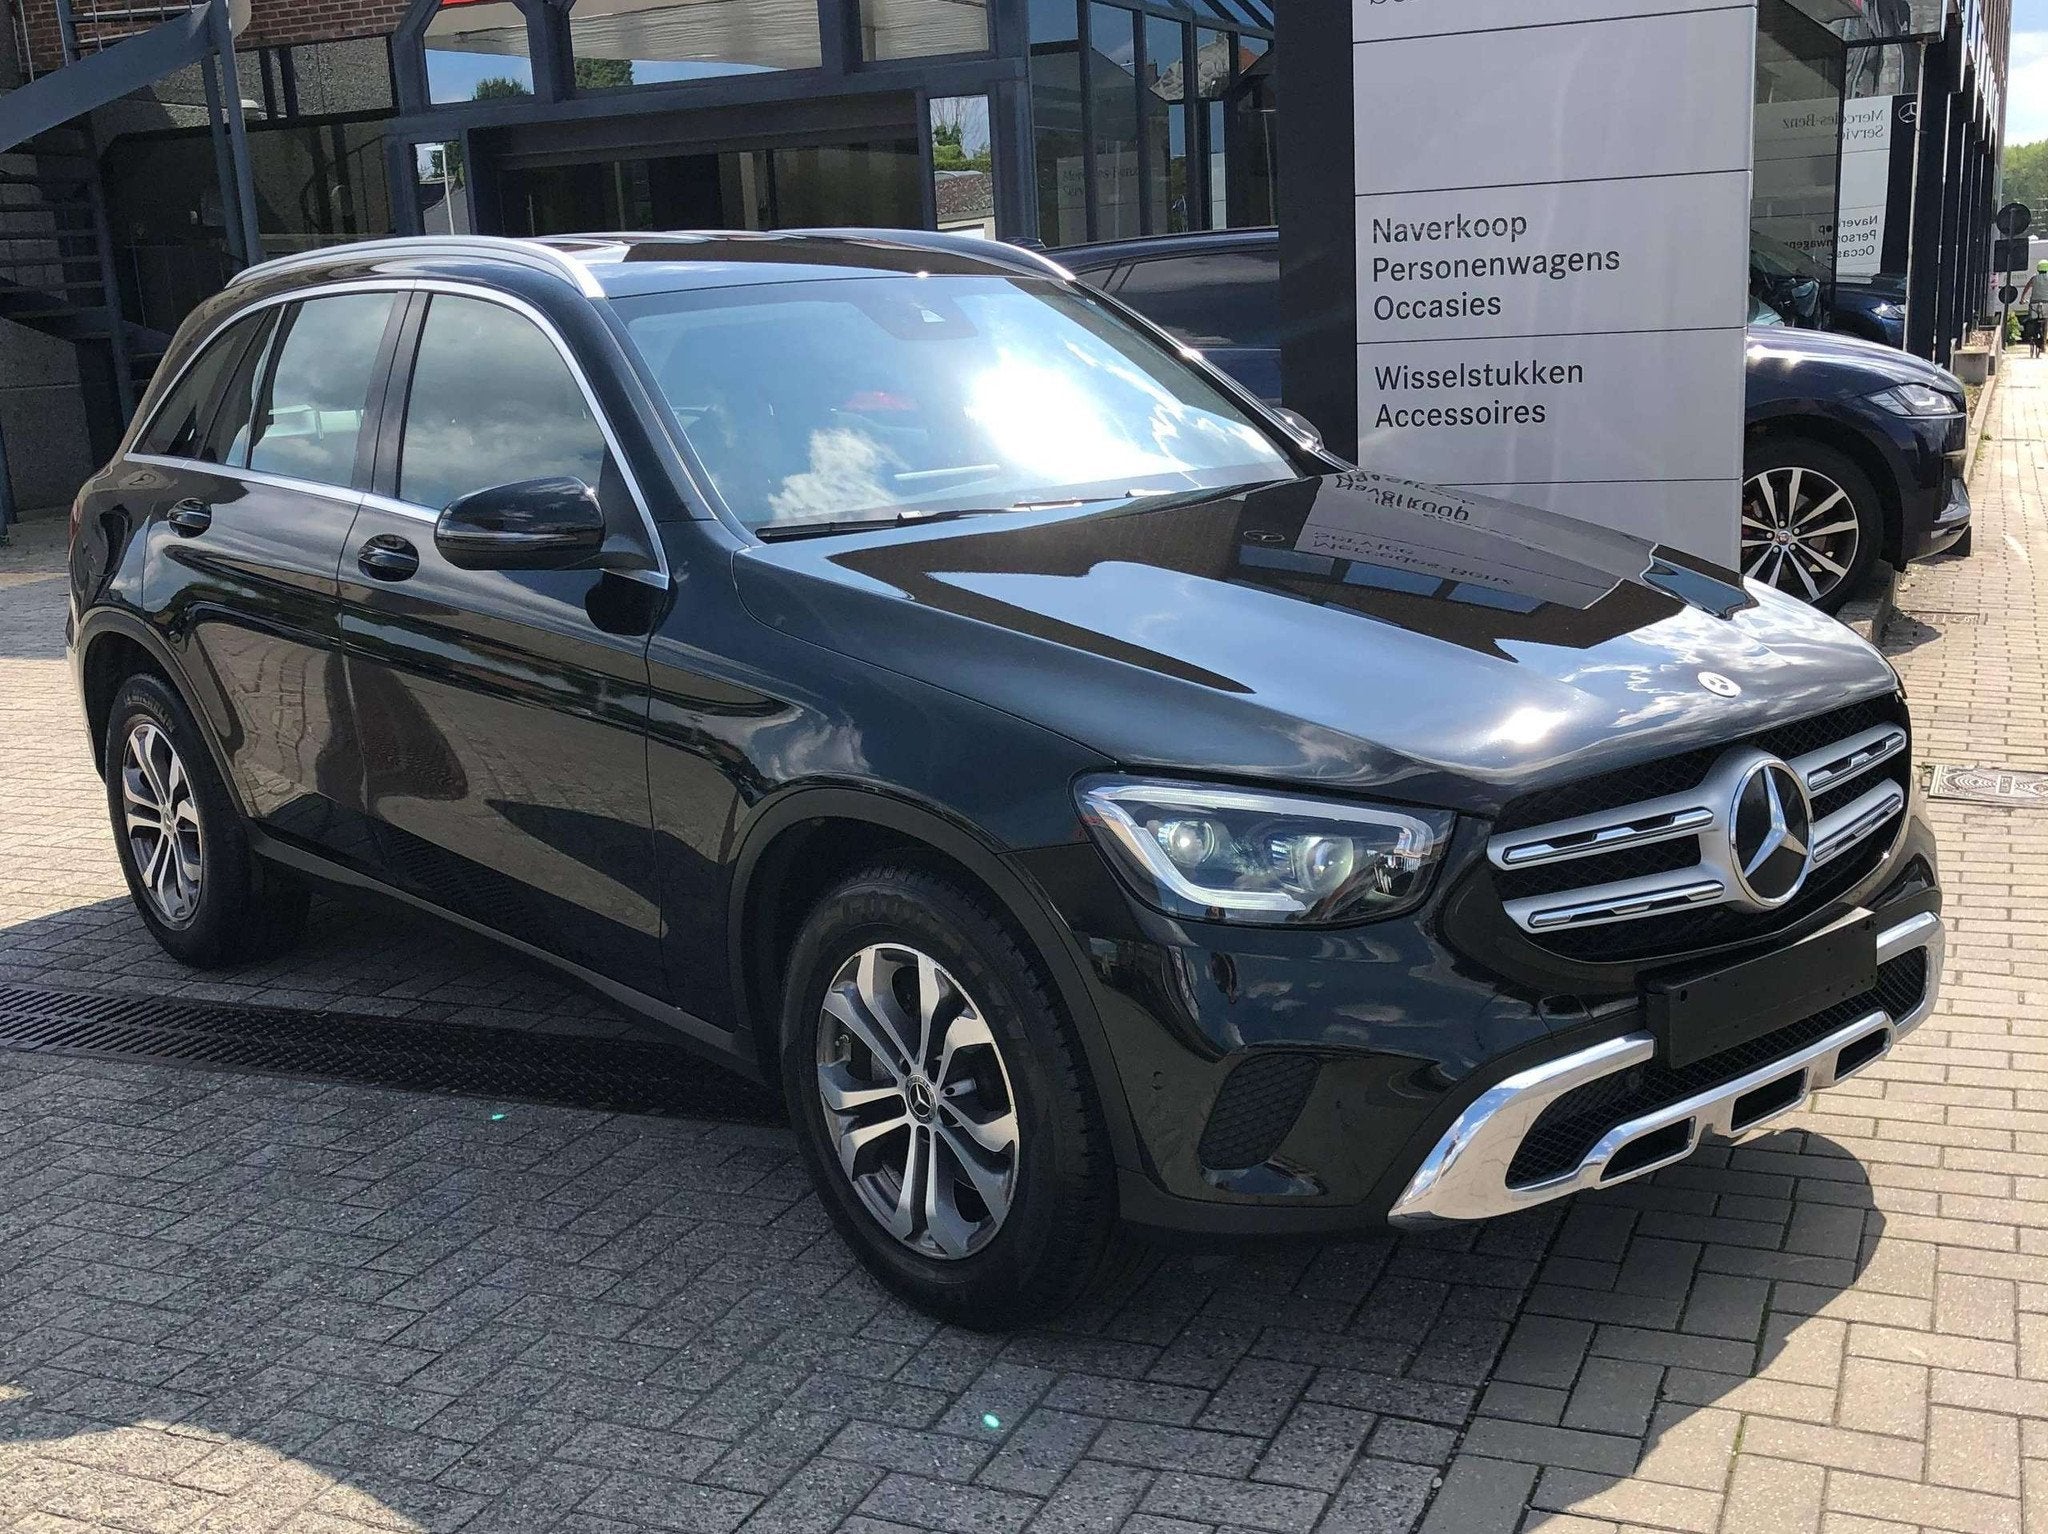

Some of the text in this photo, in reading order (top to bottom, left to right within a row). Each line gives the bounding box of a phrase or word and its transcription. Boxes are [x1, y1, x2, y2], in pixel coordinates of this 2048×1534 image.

[1373, 213, 1527, 243] Naverkoop
[1373, 250, 1620, 282] Personenwagens
[1374, 291, 1501, 320] Occasies
[1375, 360, 1583, 390] Wisselstukken
[1375, 400, 1546, 427] Accessoires
